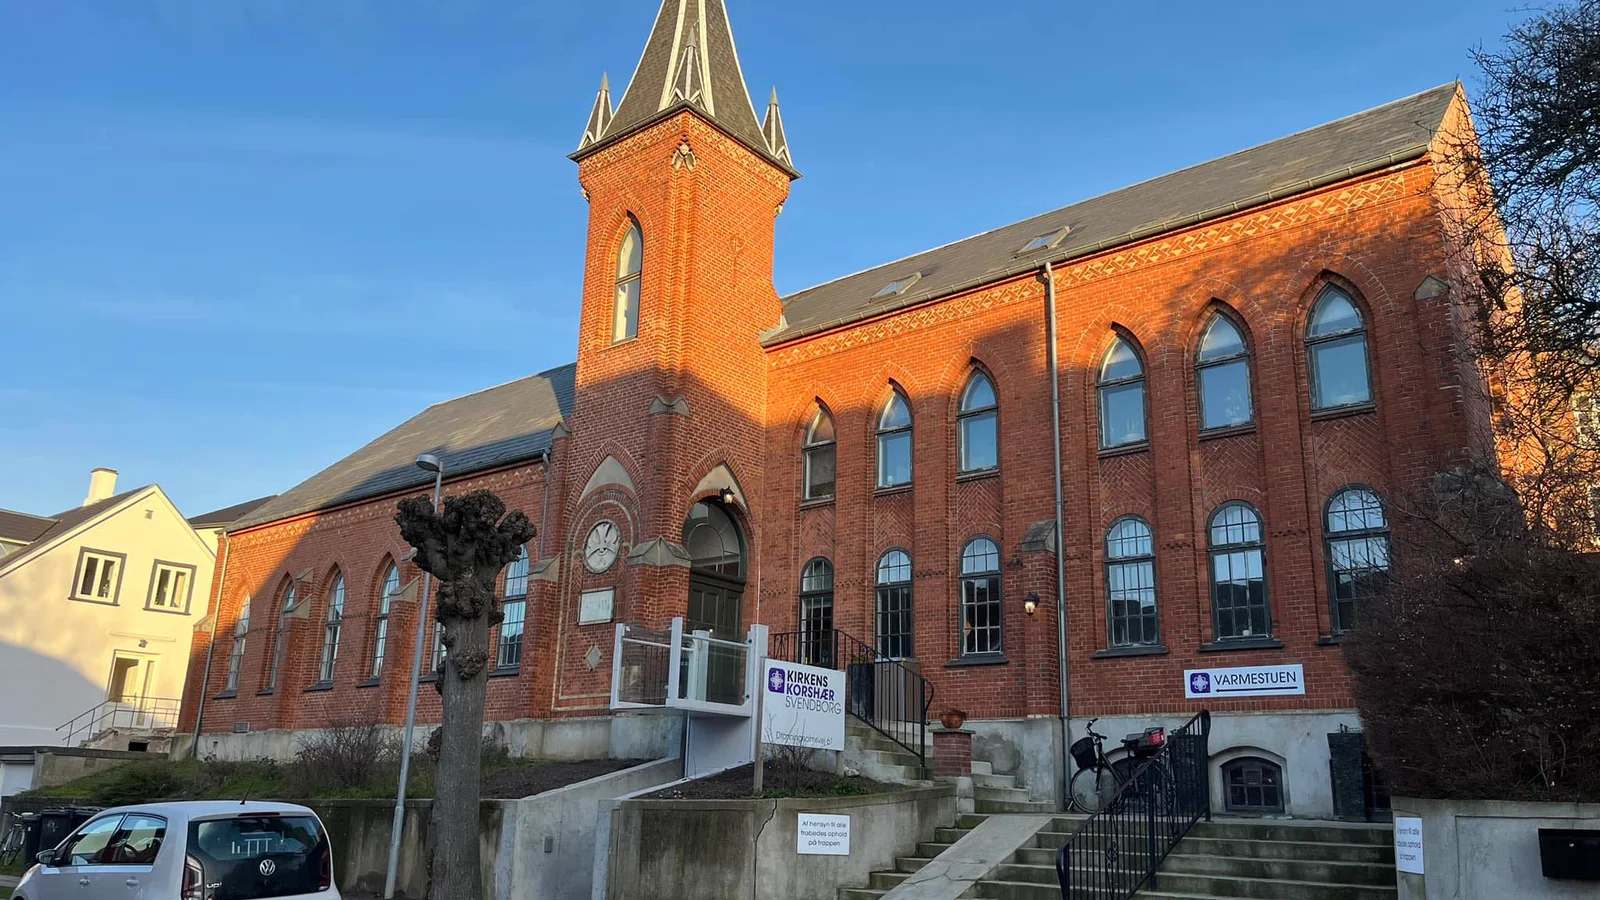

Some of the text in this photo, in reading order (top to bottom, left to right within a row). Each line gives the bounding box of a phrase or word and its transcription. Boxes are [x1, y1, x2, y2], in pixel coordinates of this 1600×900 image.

[786, 670, 829, 687] KIRKENS
[1213, 671, 1297, 685] VARMESTUEN
[786, 683, 835, 701] KORSHÆR
[785, 695, 842, 715] SVENDBORG
[818, 839, 841, 847] trappen
